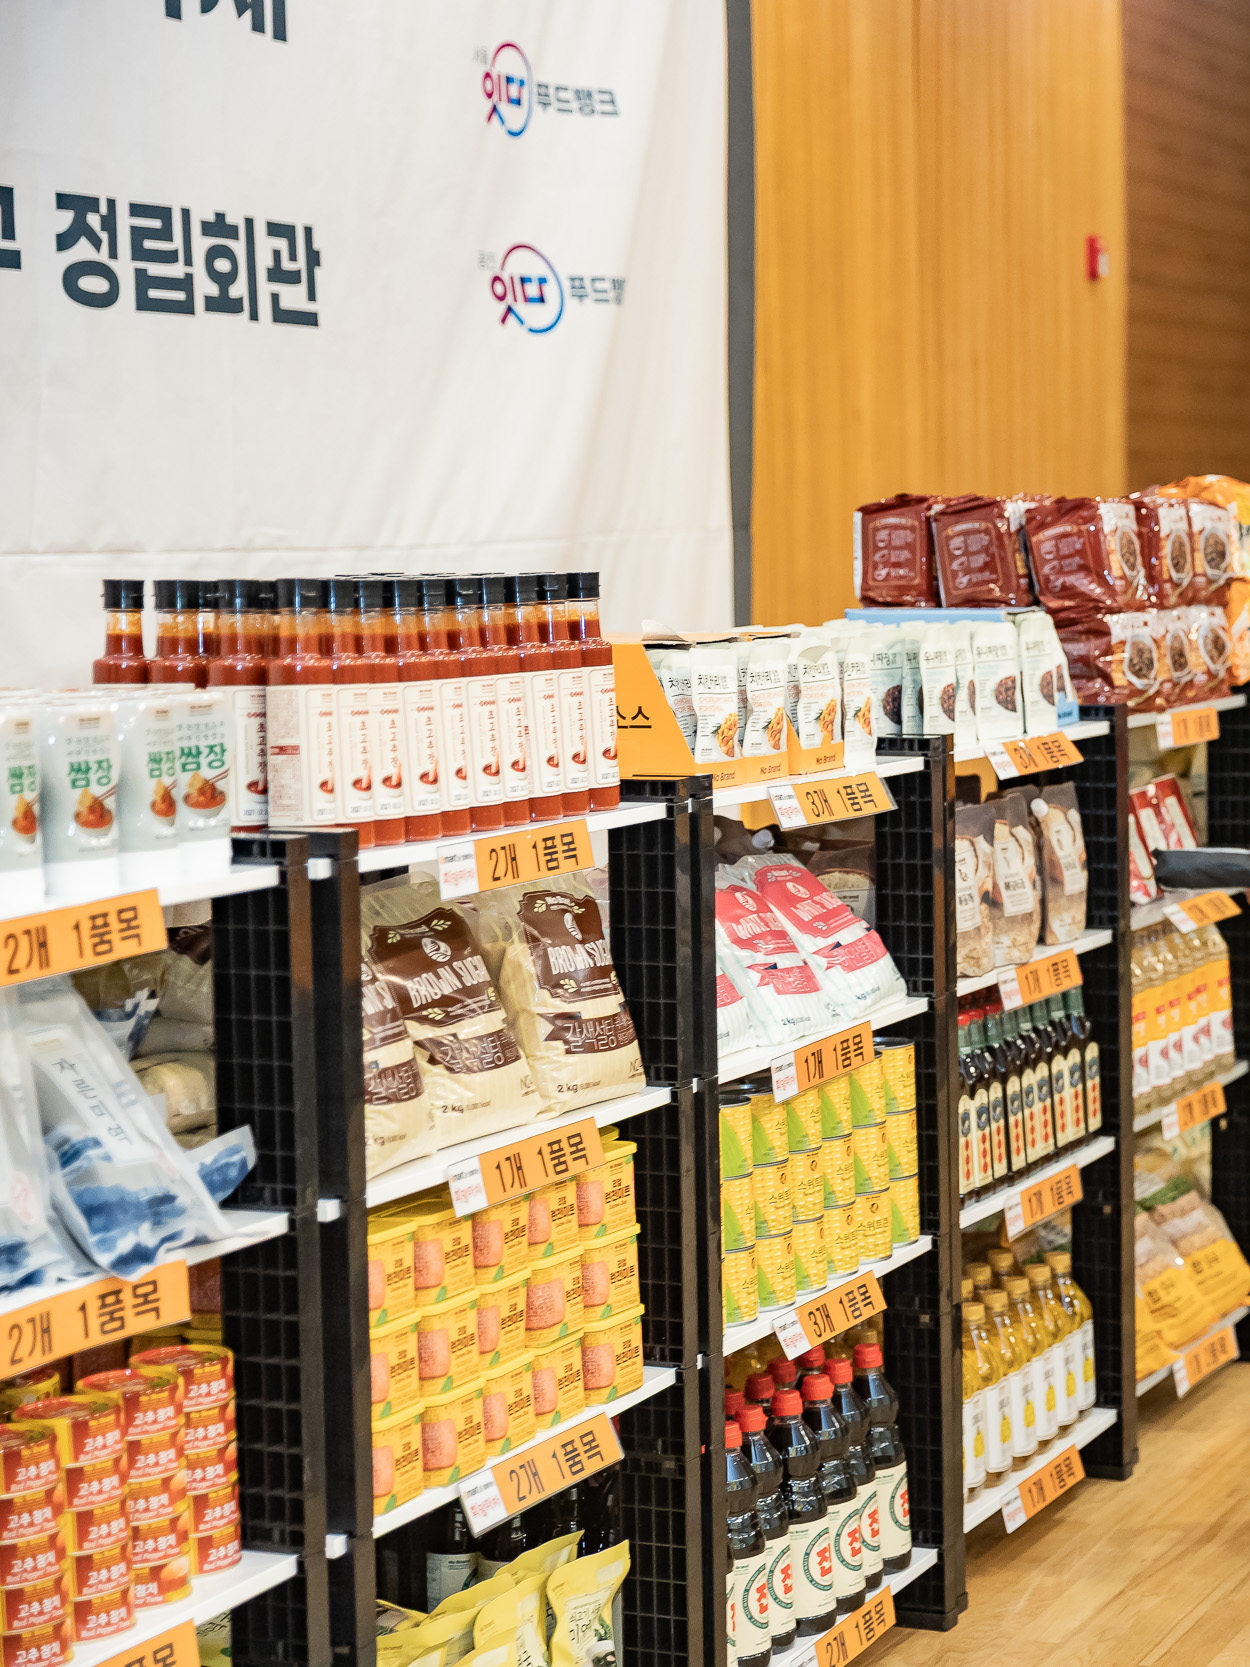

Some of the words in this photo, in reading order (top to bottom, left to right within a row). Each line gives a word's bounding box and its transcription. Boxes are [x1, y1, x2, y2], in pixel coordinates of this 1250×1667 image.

[537, 83, 619, 116] 푸드뱅크
[54, 190, 322, 328] 정립회관
[178, 742, 227, 773] 쌈장
[816, 756, 824, 765] No
[824, 754, 836, 763] Brand
[67, 758, 113, 790] 쌈장
[722, 771, 735, 780] Brand
[760, 766, 768, 775] No
[769, 763, 781, 773] Brand
[806, 788, 833, 817] 3개
[837, 782, 878, 813] 1품목
[489, 843, 520, 882] 2개
[532, 832, 578, 872] 1품목
[4, 925, 50, 975] 2개
[72, 906, 142, 959] 1품목
[547, 945, 594, 975] BROWN
[406, 966, 462, 1008] BROWN
[563, 1018, 617, 1051] 갈색설탕
[804, 1048, 825, 1083] 1개
[832, 1033, 866, 1071] 1품목
[557, 1084, 563, 1093] 2
[567, 1083, 578, 1093] kg
[442, 1105, 448, 1113] 2
[451, 1104, 464, 1114] kg
[496, 1152, 527, 1192] 1개
[538, 1132, 589, 1177] 1품목
[857, 1219, 889, 1232] 스위트콘
[808, 1303, 836, 1338] 3개
[839, 1283, 875, 1322] 1품목
[8, 1310, 53, 1366] 2개
[77, 1279, 161, 1340] 1품목
[188, 1379, 226, 1397] 고추참치
[133, 1405, 174, 1425] 고추참치
[83, 1429, 120, 1451] 고추참치
[184, 1422, 224, 1441] 고추참치
[135, 1448, 176, 1467] 고추참치
[509, 1458, 545, 1502] 2개
[552, 1430, 604, 1479] 1품목
[16, 1459, 55, 1480] 고추참치
[78, 1475, 119, 1496] 고추참치
[7, 1506, 52, 1528] 고추참치
[203, 1500, 236, 1521] 고추참치
[88, 1517, 125, 1539] 고추참치
[133, 1534, 176, 1553] 고추참치
[207, 1540, 239, 1561] 고추참치
[11, 1550, 55, 1573] 고추참치
[87, 1562, 127, 1585] 고추참치
[17, 1594, 60, 1617] 고추참치
[86, 1606, 127, 1628] 고추참치
[854, 1600, 887, 1646] 1품목
[15, 1641, 60, 1663] 고추참치
